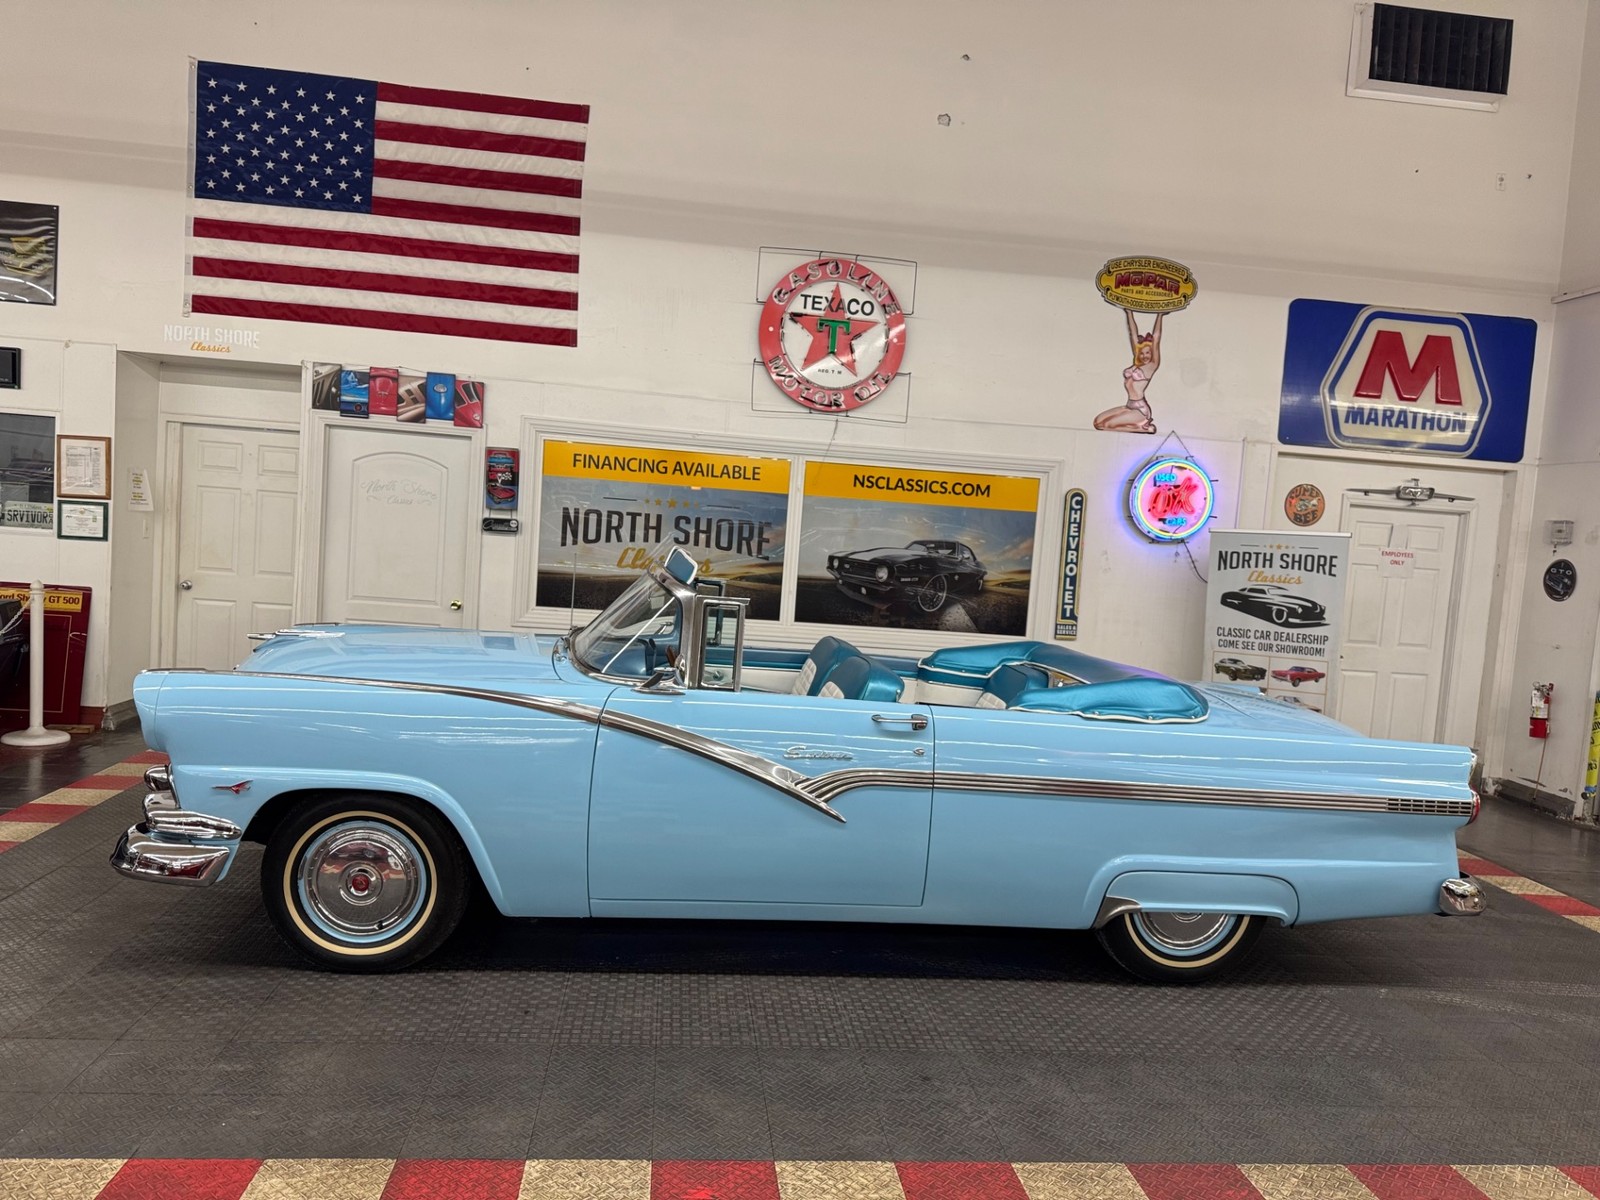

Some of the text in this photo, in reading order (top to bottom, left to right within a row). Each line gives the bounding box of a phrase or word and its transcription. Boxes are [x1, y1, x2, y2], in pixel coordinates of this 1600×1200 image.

[1110, 259, 1186, 277] USE CHRYSLER ENGINEERED
[1114, 271, 1181, 296] MOPAR
[800, 293, 875, 316] TEXACO
[163, 323, 261, 349] NORTH SHORE
[190, 341, 231, 353] Classics
[1344, 405, 1468, 433] MARATHON
[572, 453, 761, 481] FINANCING AVAILABLE
[853, 474, 991, 498] NSCLASSICS.COM
[1155, 473, 1176, 482] USED
[1150, 477, 1198, 518] OK
[6, 509, 48, 524] SRVIVOR
[1293, 510, 1318, 524] BEE
[560, 506, 772, 561] NORTH SHORE
[1063, 496, 1082, 617] CHEVROLET
[1217, 550, 1338, 578] NORTH SHORE
[1381, 551, 1414, 559] EMPLOYEES
[1247, 570, 1304, 585] Classics
[1550, 567, 1572, 575] GTO
[48, 595, 62, 604] GT
[62, 596, 80, 605] 500
[1216, 626, 1329, 646] CLASSIC CAR DEALERSHIP
[1218, 638, 1325, 657] COME SEE OUR SHOWROOM!
